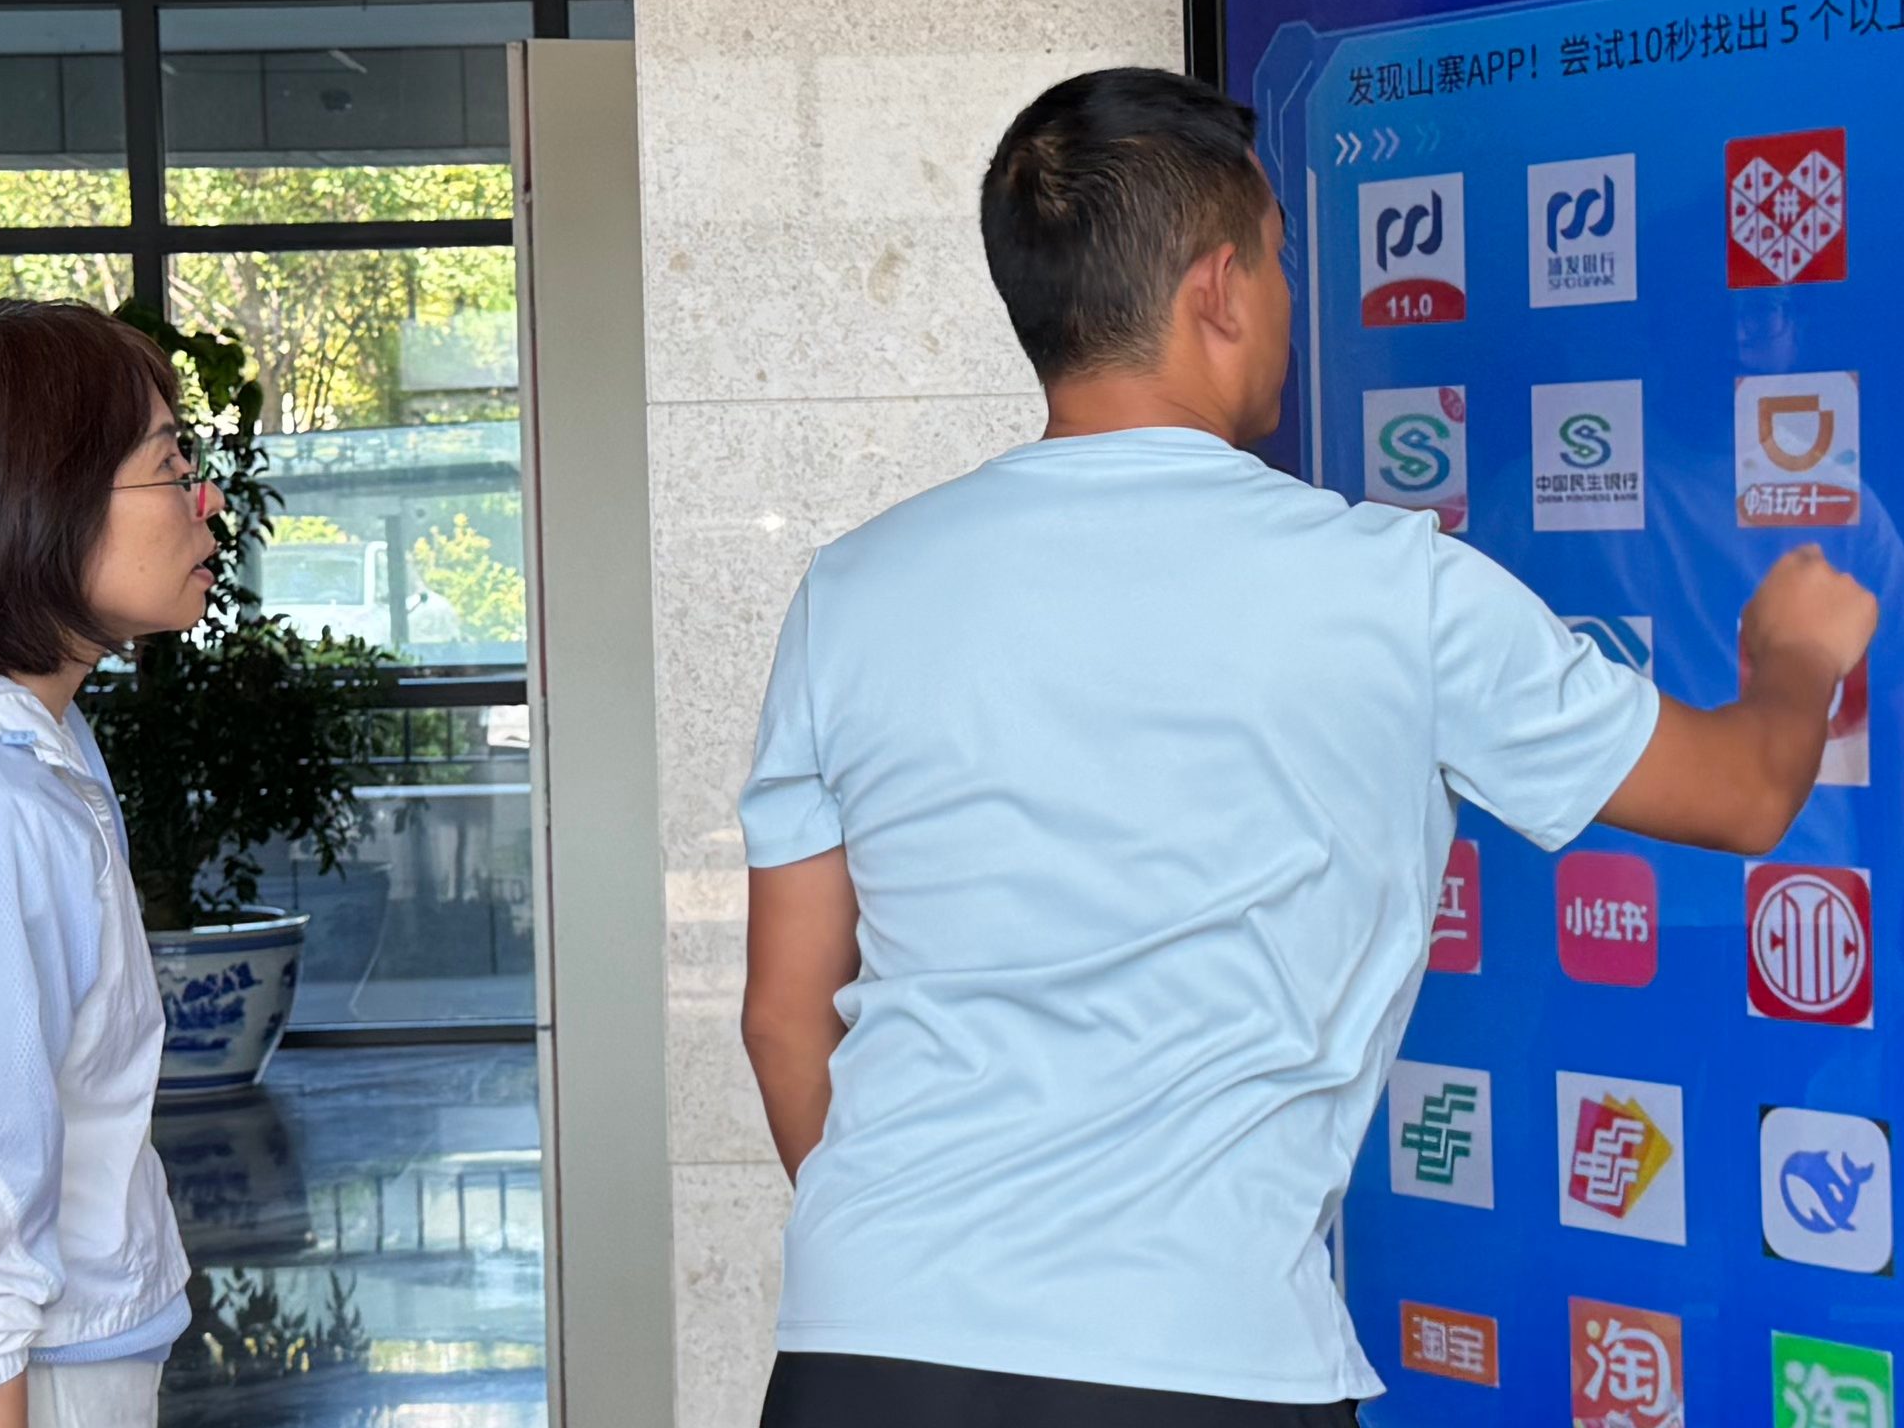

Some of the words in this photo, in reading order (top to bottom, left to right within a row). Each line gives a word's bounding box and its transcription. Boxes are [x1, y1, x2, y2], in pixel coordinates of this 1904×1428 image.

[1780, 4, 1798, 44] 5
[1386, 293, 1433, 319] 11.0
[1536, 472, 1639, 492] 中国民生银行
[1744, 484, 1851, 517] 畅玩十一
[1565, 897, 1649, 943] 小红书
[1582, 1318, 1672, 1416] 淘
